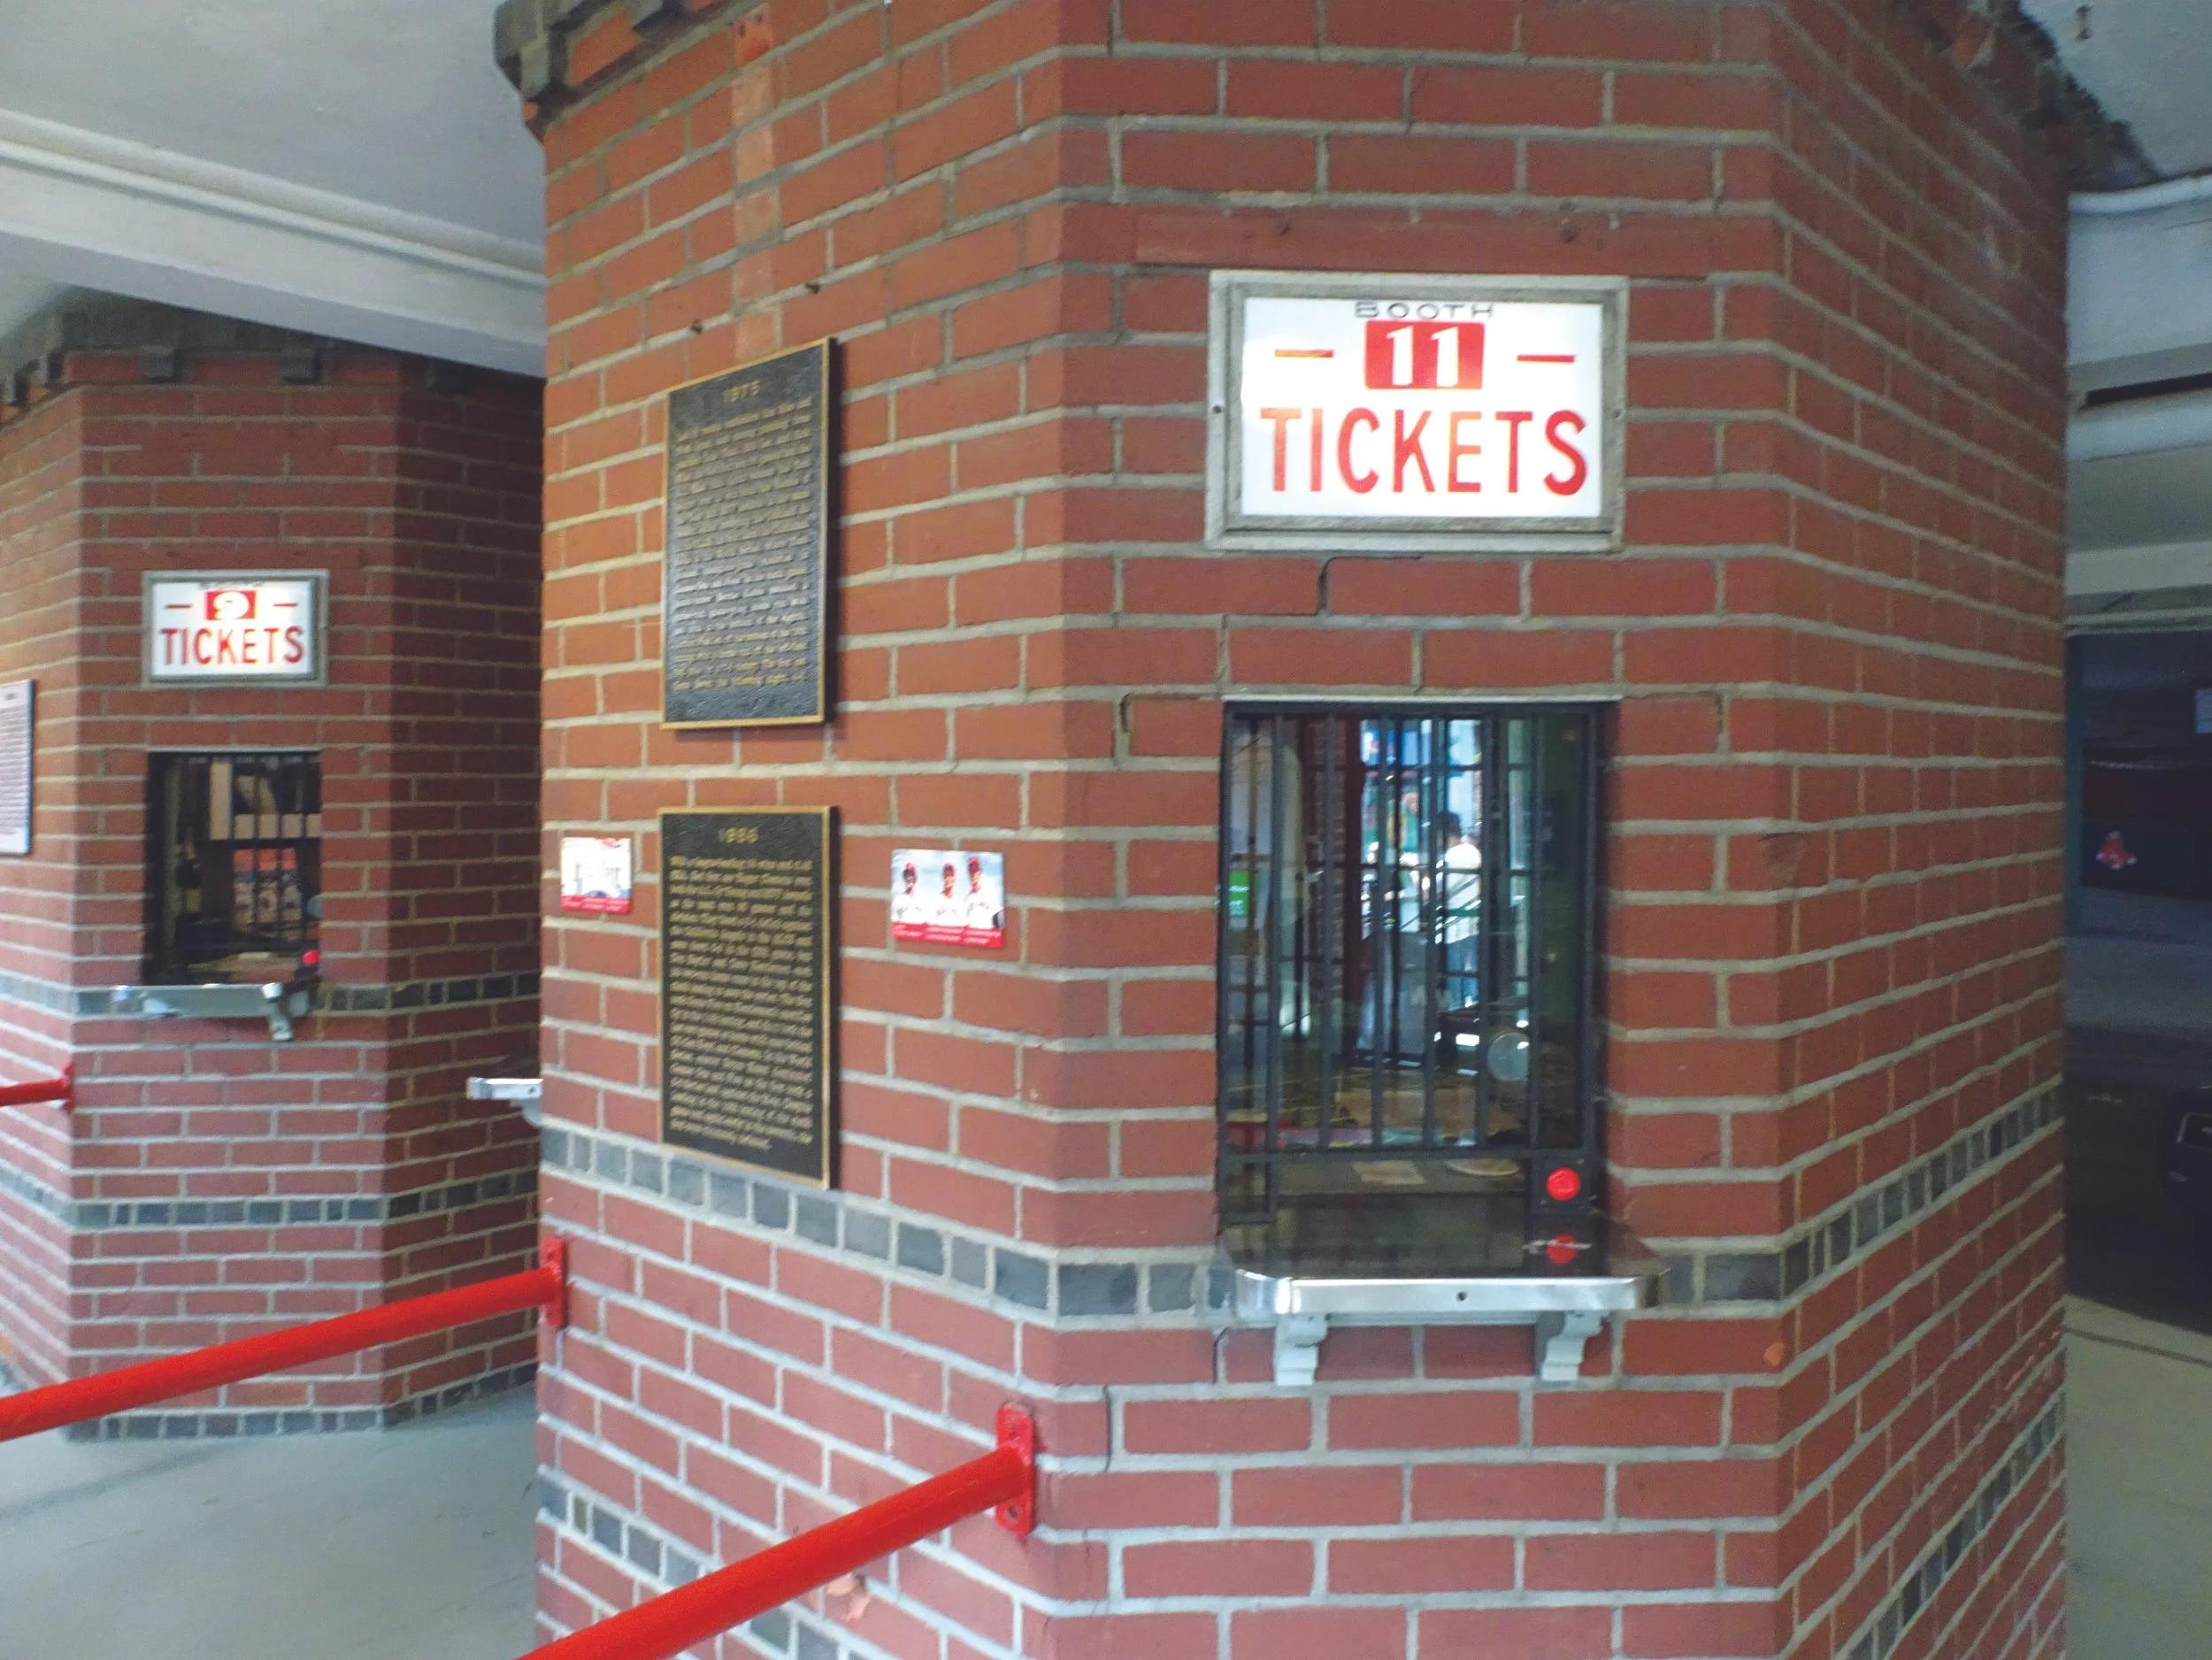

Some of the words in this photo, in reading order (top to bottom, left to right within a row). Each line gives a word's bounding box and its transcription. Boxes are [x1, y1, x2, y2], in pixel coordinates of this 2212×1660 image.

[1354, 300, 1494, 320] BOOTH
[1386, 325, 1460, 388] 11
[1260, 406, 1587, 496] TICKETS
[213, 590, 250, 620] 9
[160, 625, 305, 665] TICKETS
